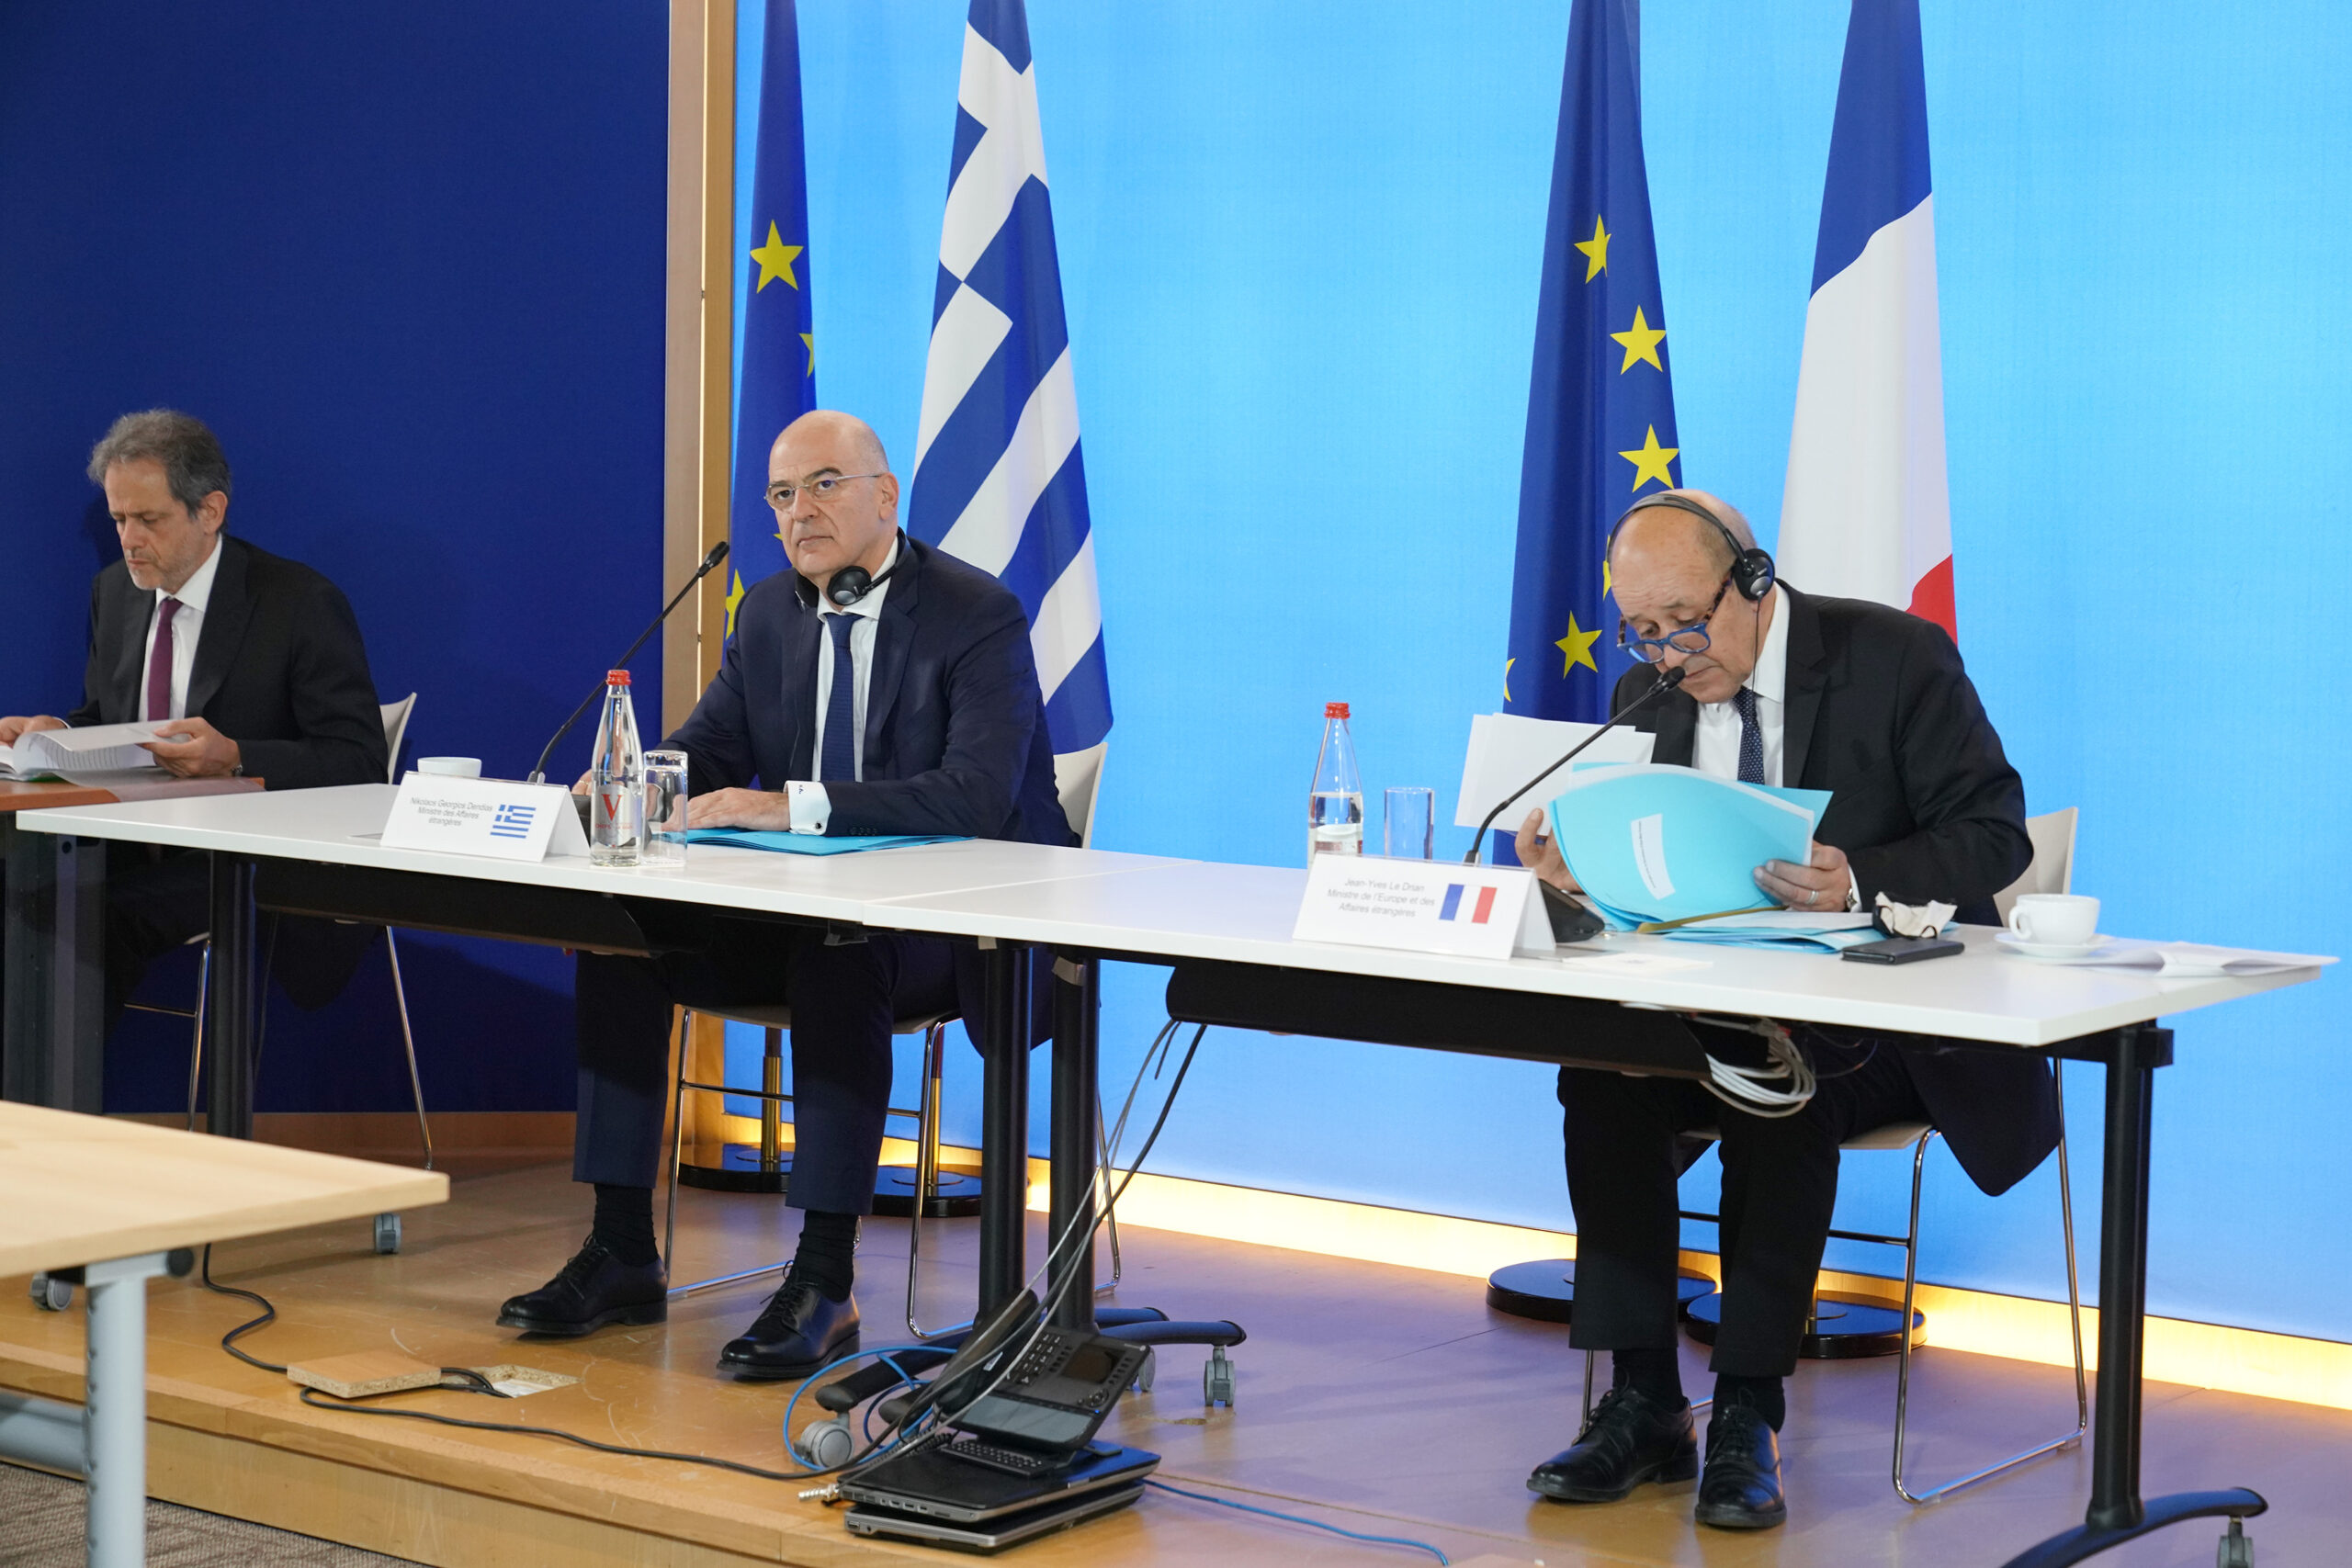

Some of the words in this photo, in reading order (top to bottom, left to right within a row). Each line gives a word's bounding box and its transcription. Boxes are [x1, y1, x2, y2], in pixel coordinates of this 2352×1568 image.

[601, 794, 624, 821] V
[1345, 879, 1387, 889] Jean-Yves
[1389, 882, 1400, 890] Le
[1402, 882, 1425, 891] Drian
[1327, 889, 1359, 899] Ministre
[1361, 892, 1372, 900] de
[1374, 893, 1408, 904] l'Europe
[1419, 897, 1435, 906] des
[1339, 903, 1370, 913] Affaires
